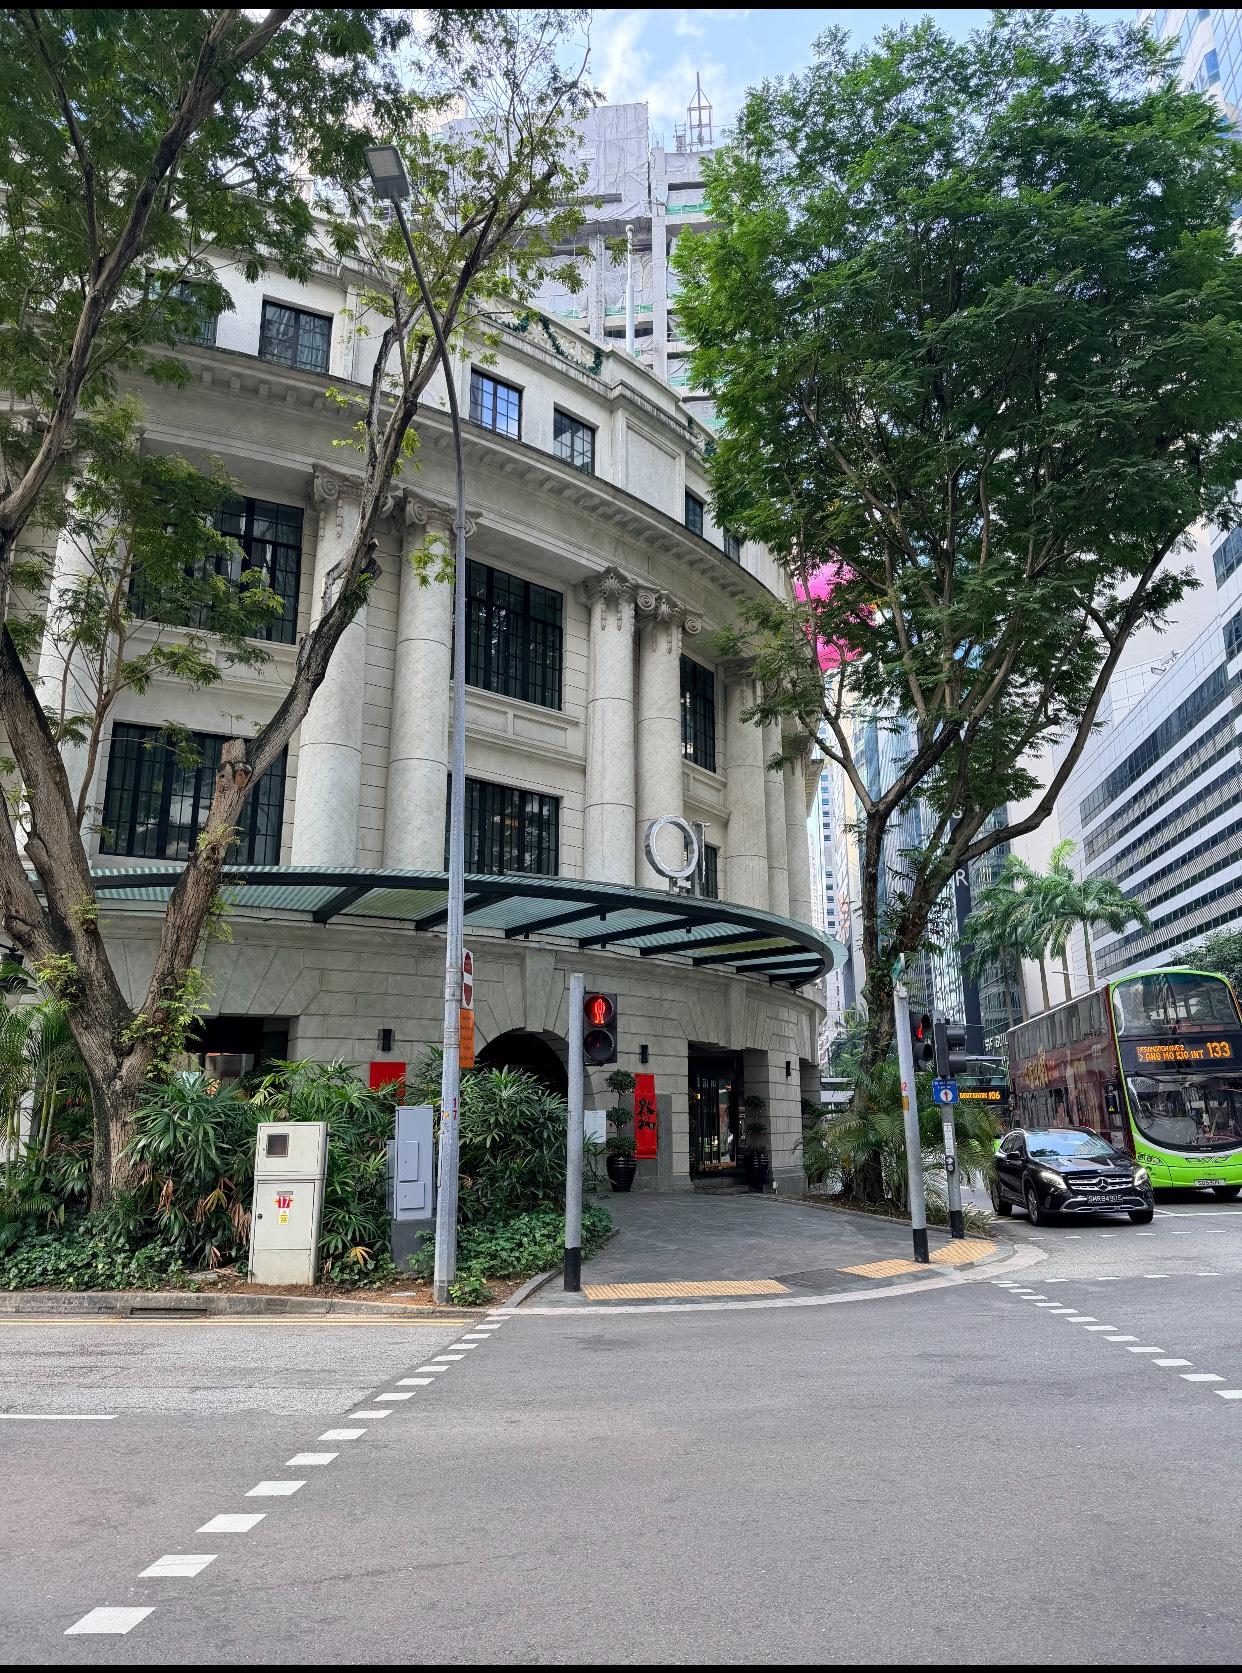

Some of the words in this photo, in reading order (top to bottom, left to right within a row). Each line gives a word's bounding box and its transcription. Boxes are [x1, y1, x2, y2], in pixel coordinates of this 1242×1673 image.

[1145, 1053, 1161, 1061] ANG
[1176, 1051, 1189, 1059] KIO
[1191, 1049, 1204, 1058] INT
[1206, 1042, 1231, 1058] 133
[988, 1091, 1001, 1100] 106
[279, 1196, 290, 1208] 17
